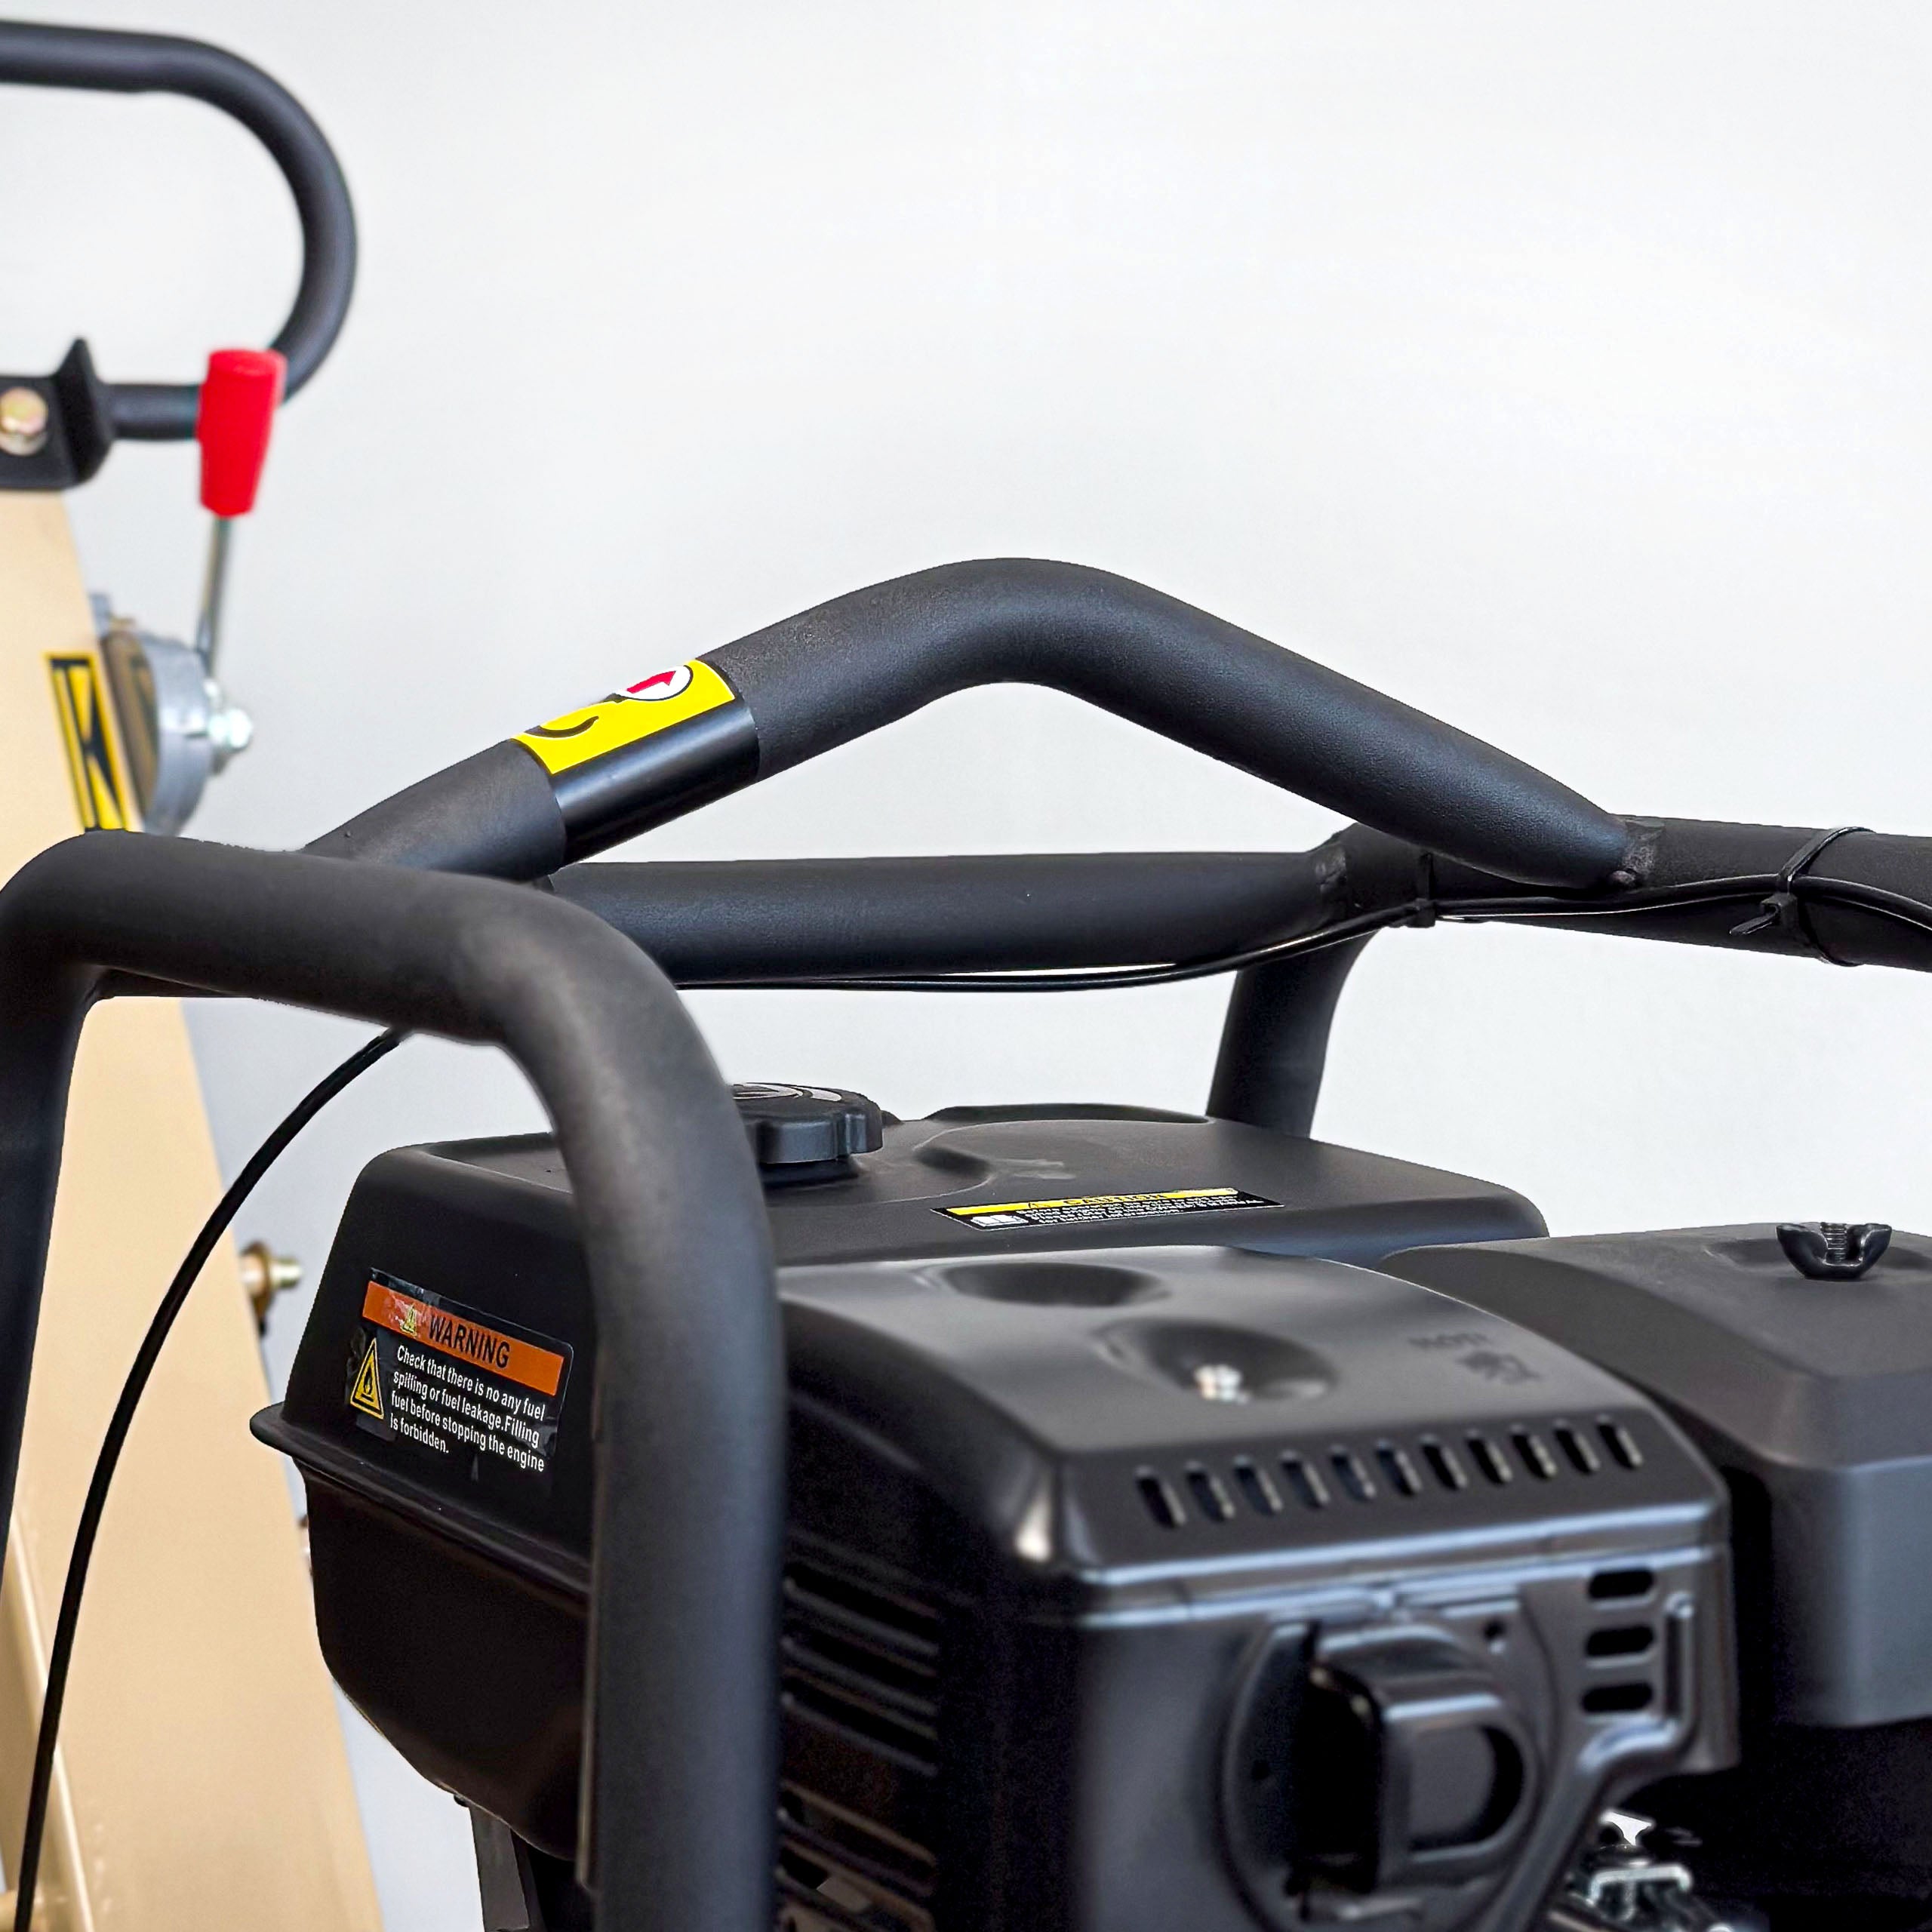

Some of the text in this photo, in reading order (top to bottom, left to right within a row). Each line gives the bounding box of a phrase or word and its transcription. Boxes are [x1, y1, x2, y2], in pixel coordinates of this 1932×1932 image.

[1064, 1194, 1168, 1205] CAUTION
[429, 1314, 510, 1368] WARNING
[397, 1345, 546, 1421] Check that there is no any fuel
[429, 1387, 440, 1401] or
[441, 1389, 460, 1411] fuel
[392, 1390, 545, 1472] fuel before stopping the engine
[400, 1417, 449, 1454] forbidden.
